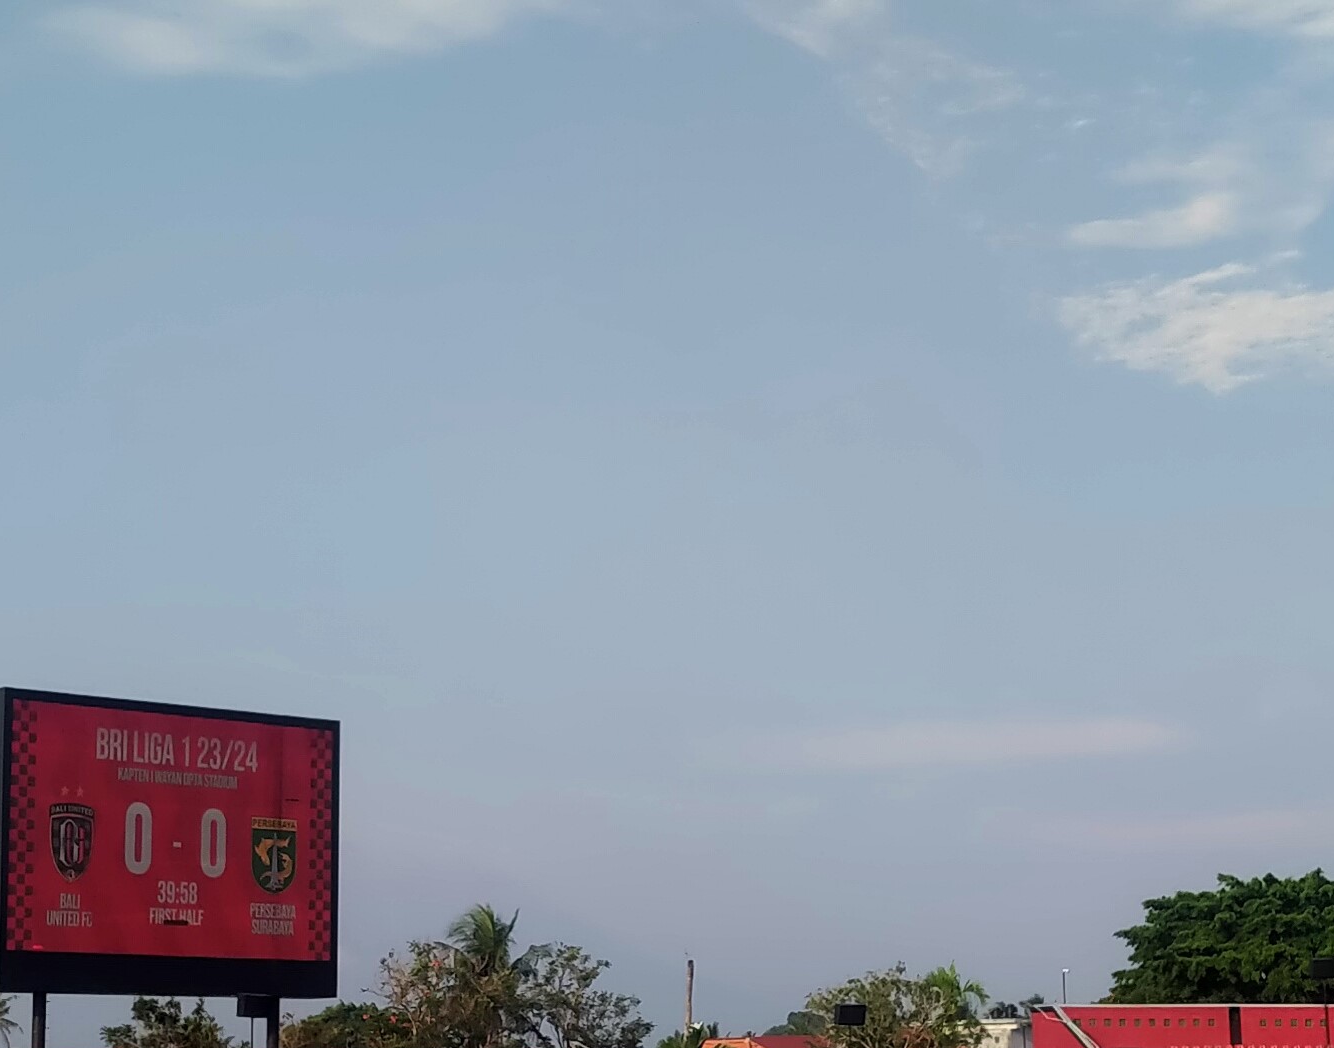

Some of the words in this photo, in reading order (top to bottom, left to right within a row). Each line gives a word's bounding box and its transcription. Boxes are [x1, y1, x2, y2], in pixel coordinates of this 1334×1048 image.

[96, 728, 127, 761] BRI
[133, 731, 174, 766] LIGA
[182, 736, 190, 767] 1
[197, 736, 258, 772] 23/24
[118, 767, 149, 782] KAPTEN
[252, 818, 296, 829] PERSEBAYA
[125, 801, 152, 875] 0
[200, 808, 226, 878] 0
[157, 880, 198, 905] 39:58
[60, 893, 80, 910] BALI
[46, 910, 79, 926] UNITED
[81, 911, 93, 928] FC
[150, 907, 177, 925] FIRST
[177, 909, 204, 926] HALF
[250, 903, 296, 919] PERSEBAYA
[251, 919, 295, 936] SURABAYA
